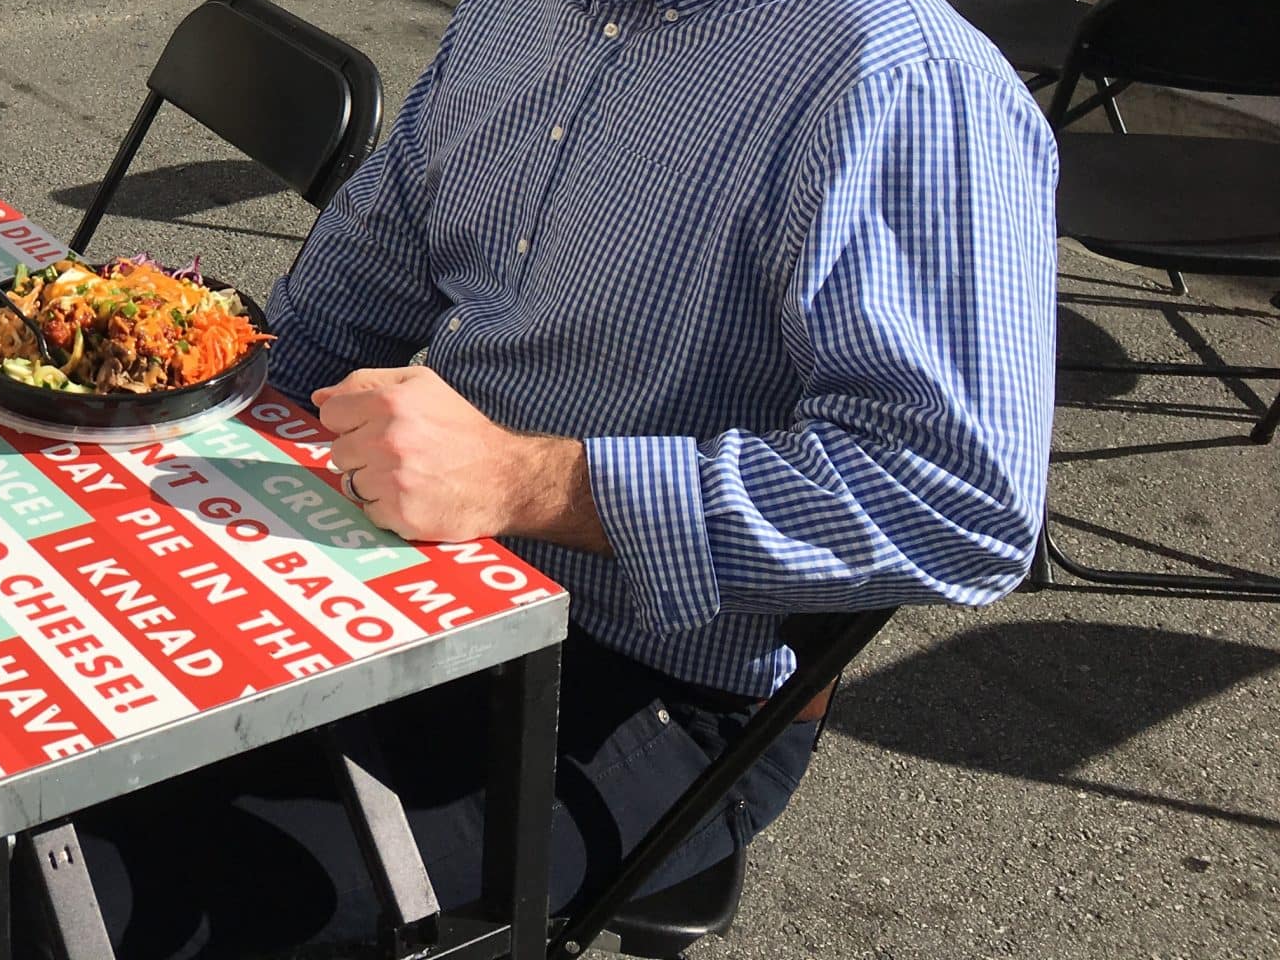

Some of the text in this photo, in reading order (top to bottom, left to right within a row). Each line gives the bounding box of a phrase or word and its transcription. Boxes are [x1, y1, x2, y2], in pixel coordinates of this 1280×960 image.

[0, 225, 62, 264] DILL
[38, 442, 335, 682] DAY PIE IN THE
[198, 496, 271, 543] GO
[262, 550, 396, 644] BACO
[262, 475, 401, 567] CRUST
[56, 535, 225, 680] I KNEAD
